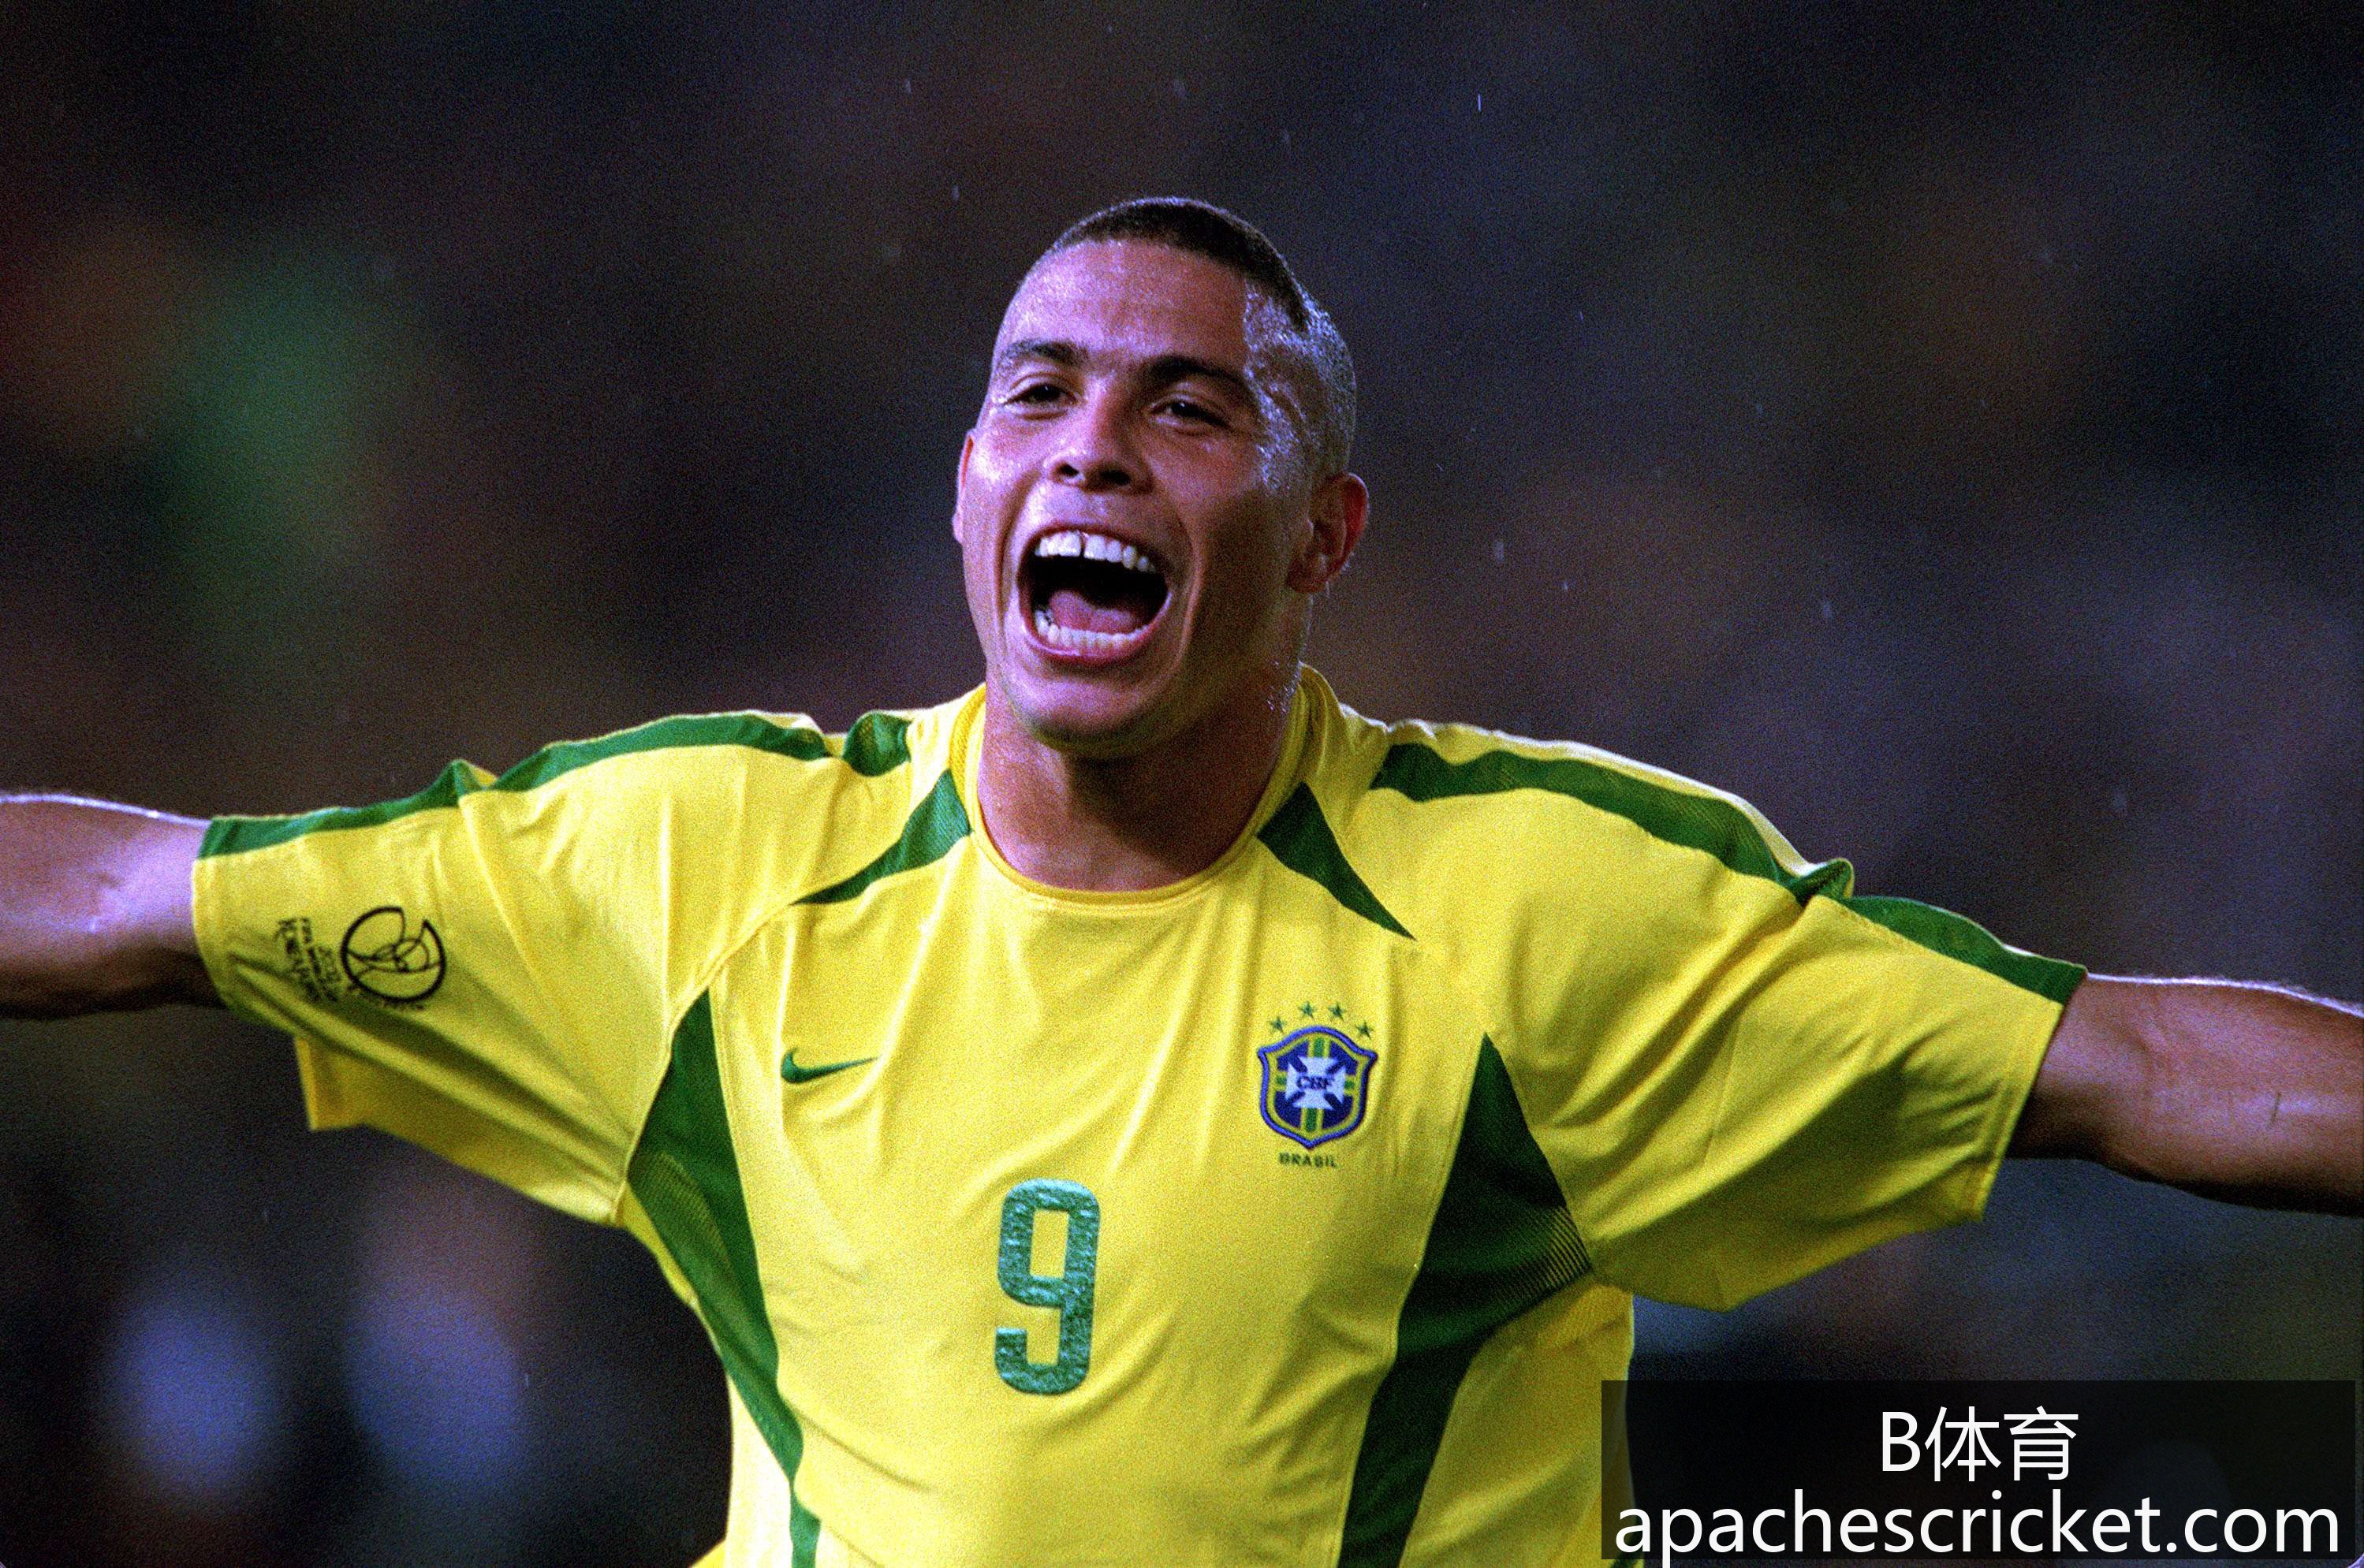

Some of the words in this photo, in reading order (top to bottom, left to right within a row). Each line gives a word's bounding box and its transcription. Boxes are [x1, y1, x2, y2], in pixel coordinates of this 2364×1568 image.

[1296, 1075, 1335, 1090] CBF
[1278, 1152, 1338, 1168] BRASIL
[994, 1179, 1100, 1395] 9
